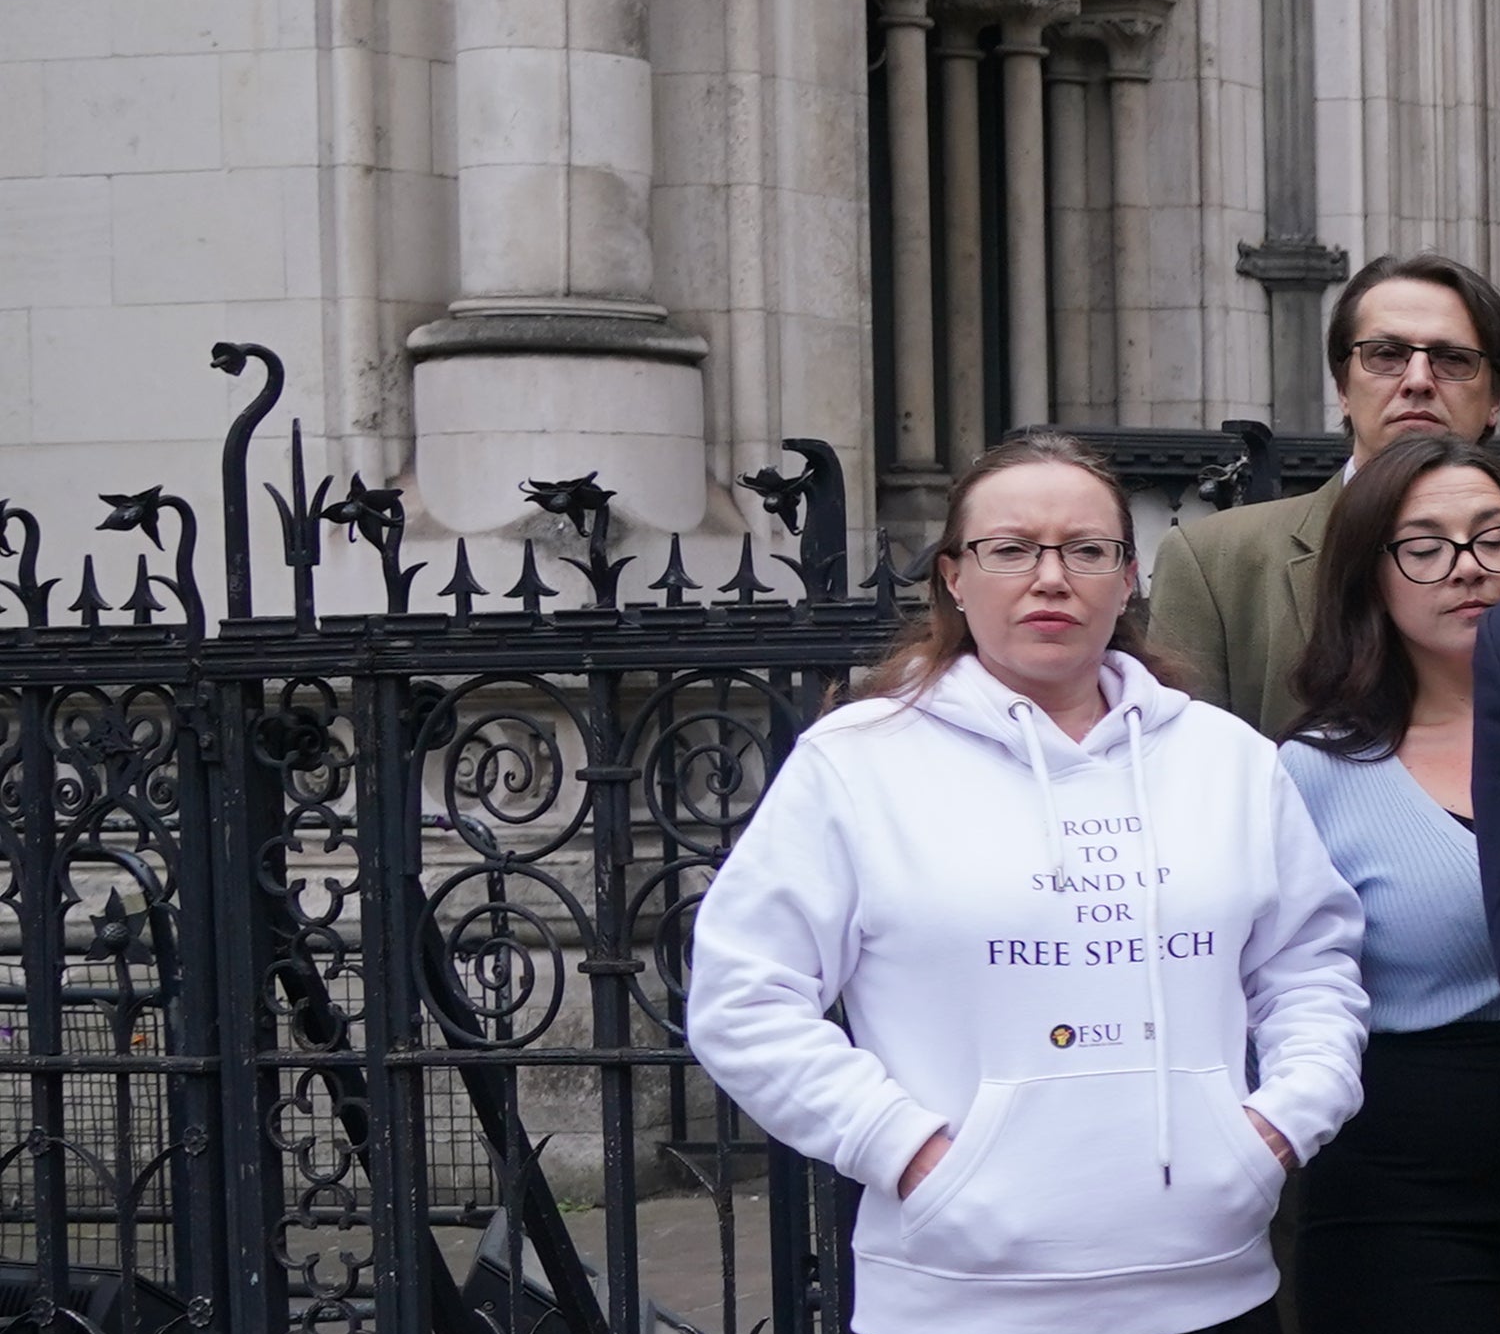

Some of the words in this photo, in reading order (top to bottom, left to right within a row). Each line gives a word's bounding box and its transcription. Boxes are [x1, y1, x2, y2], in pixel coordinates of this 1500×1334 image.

[1043, 816, 1143, 837] ROUD
[1078, 845, 1118, 864] TO
[1032, 873, 1126, 893] STAND
[1076, 903, 1135, 923] FOR
[987, 940, 1071, 966] FREE
[1085, 931, 1215, 966] SPECH
[1078, 1024, 1122, 1043] FSU
